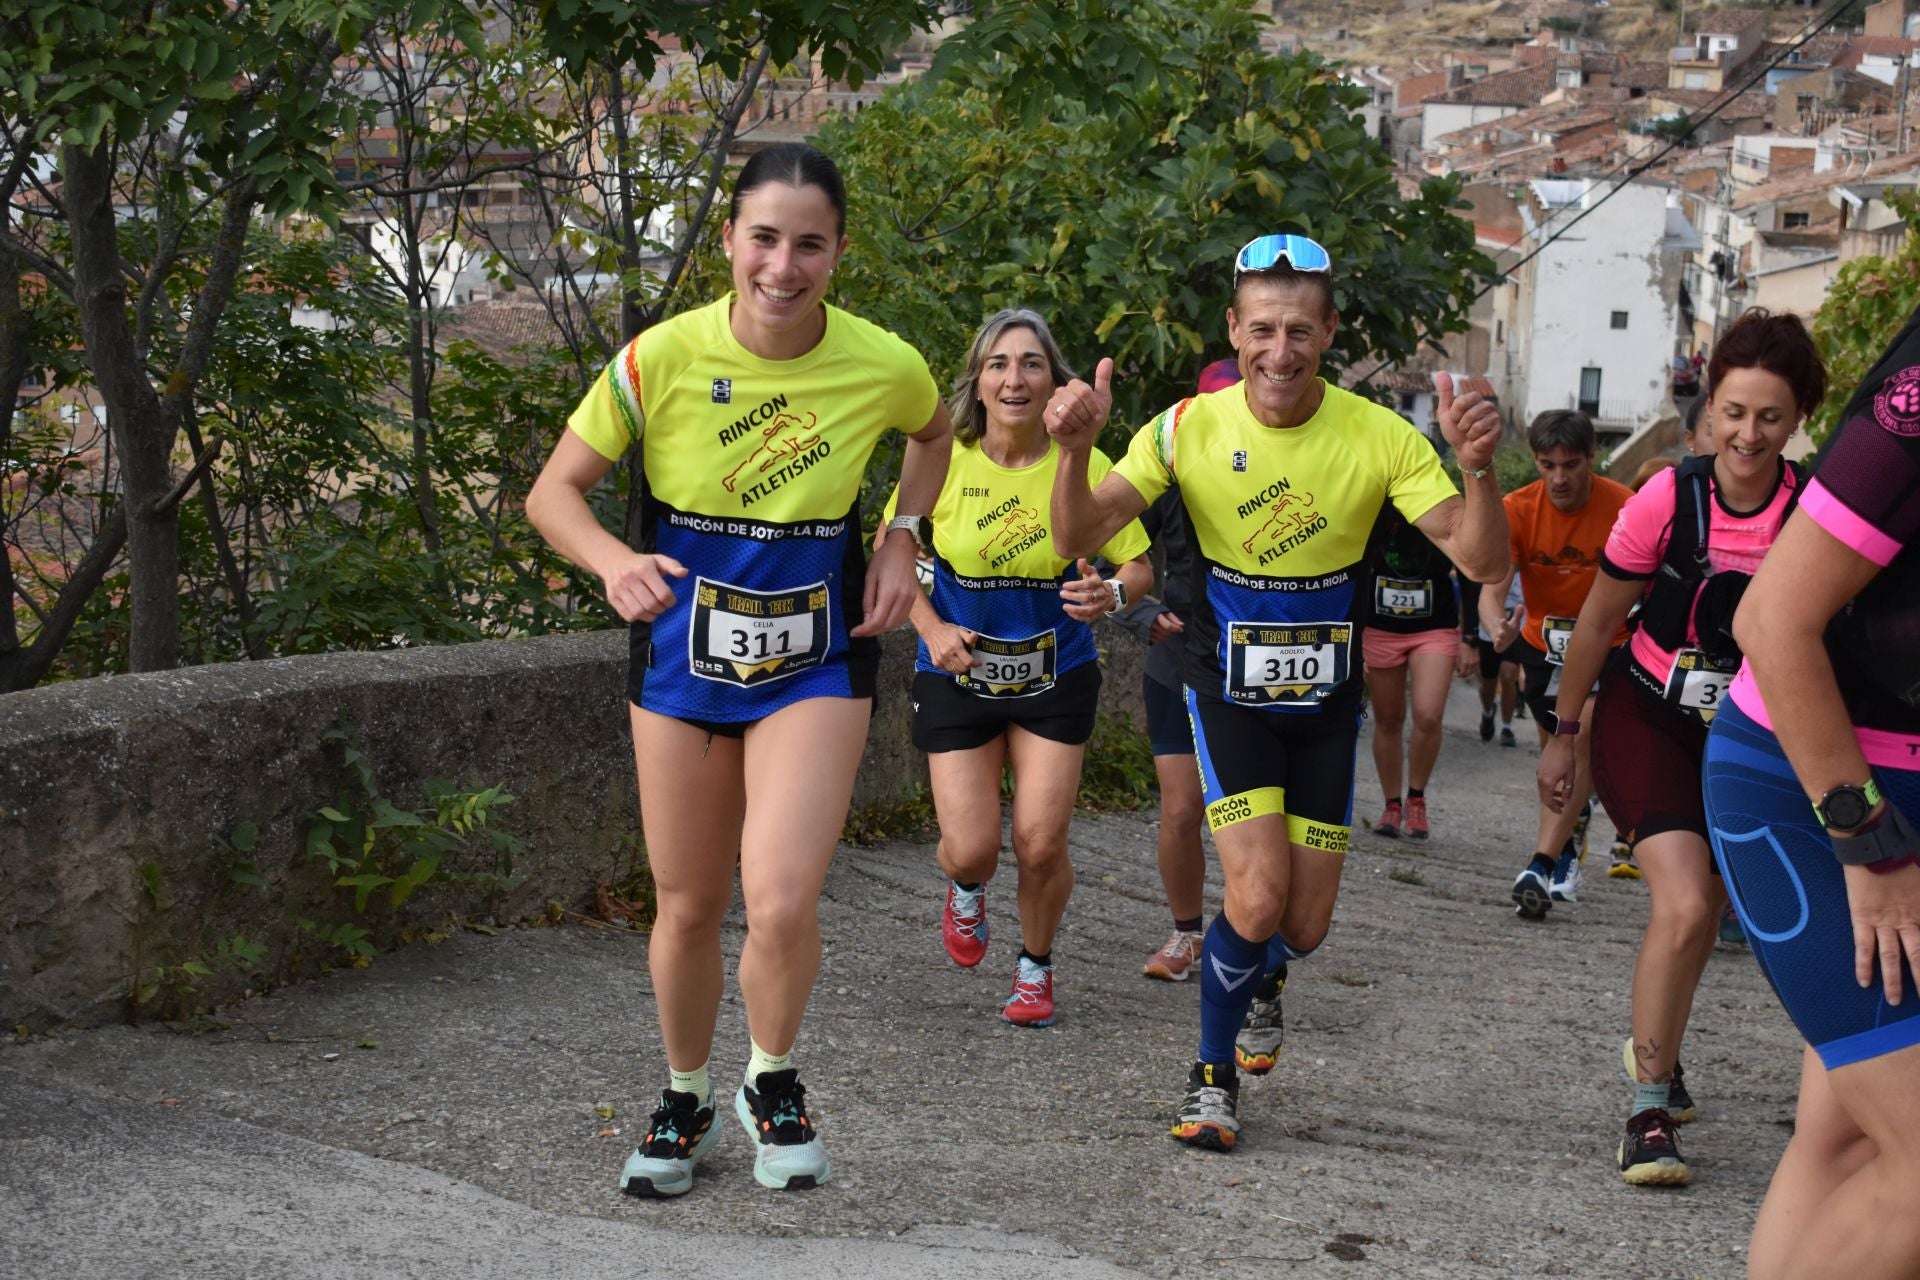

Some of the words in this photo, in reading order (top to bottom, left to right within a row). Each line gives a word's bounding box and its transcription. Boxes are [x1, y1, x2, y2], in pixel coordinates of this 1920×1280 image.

[718, 393, 788, 447] RINCON
[741, 441, 831, 508] ATLETISMO
[962, 487, 990, 498] GOBIK
[1237, 476, 1291, 519] RINCON
[670, 512, 724, 533] RINCÓN
[728, 521, 747, 535] DE
[976, 494, 1021, 530] RINCON
[991, 527, 1047, 569] ATLETISMO
[1257, 515, 1328, 567] ATLETISMO
[983, 579, 996, 588] DE
[1212, 565, 1249, 586] RINCÓN
[1251, 579, 1265, 590] DE
[1268, 580, 1298, 591] SOTO
[1305, 579, 1321, 590] LA
[1322, 571, 1349, 588] RIOJA
[727, 594, 764, 615] TRAIL
[767, 597, 795, 615] 13K
[1391, 594, 1417, 607] 221
[730, 629, 792, 659] 311
[1260, 630, 1293, 644] TRAIL
[1296, 629, 1318, 642] 13K
[985, 662, 1031, 681] 309
[1264, 656, 1319, 682] 310
[1213, 817, 1222, 828] DE
[1223, 807, 1252, 825] SOTO
[1305, 836, 1322, 847] DE
[1325, 840, 1347, 851] SOTO
[1306, 825, 1349, 842] RINCÓN
